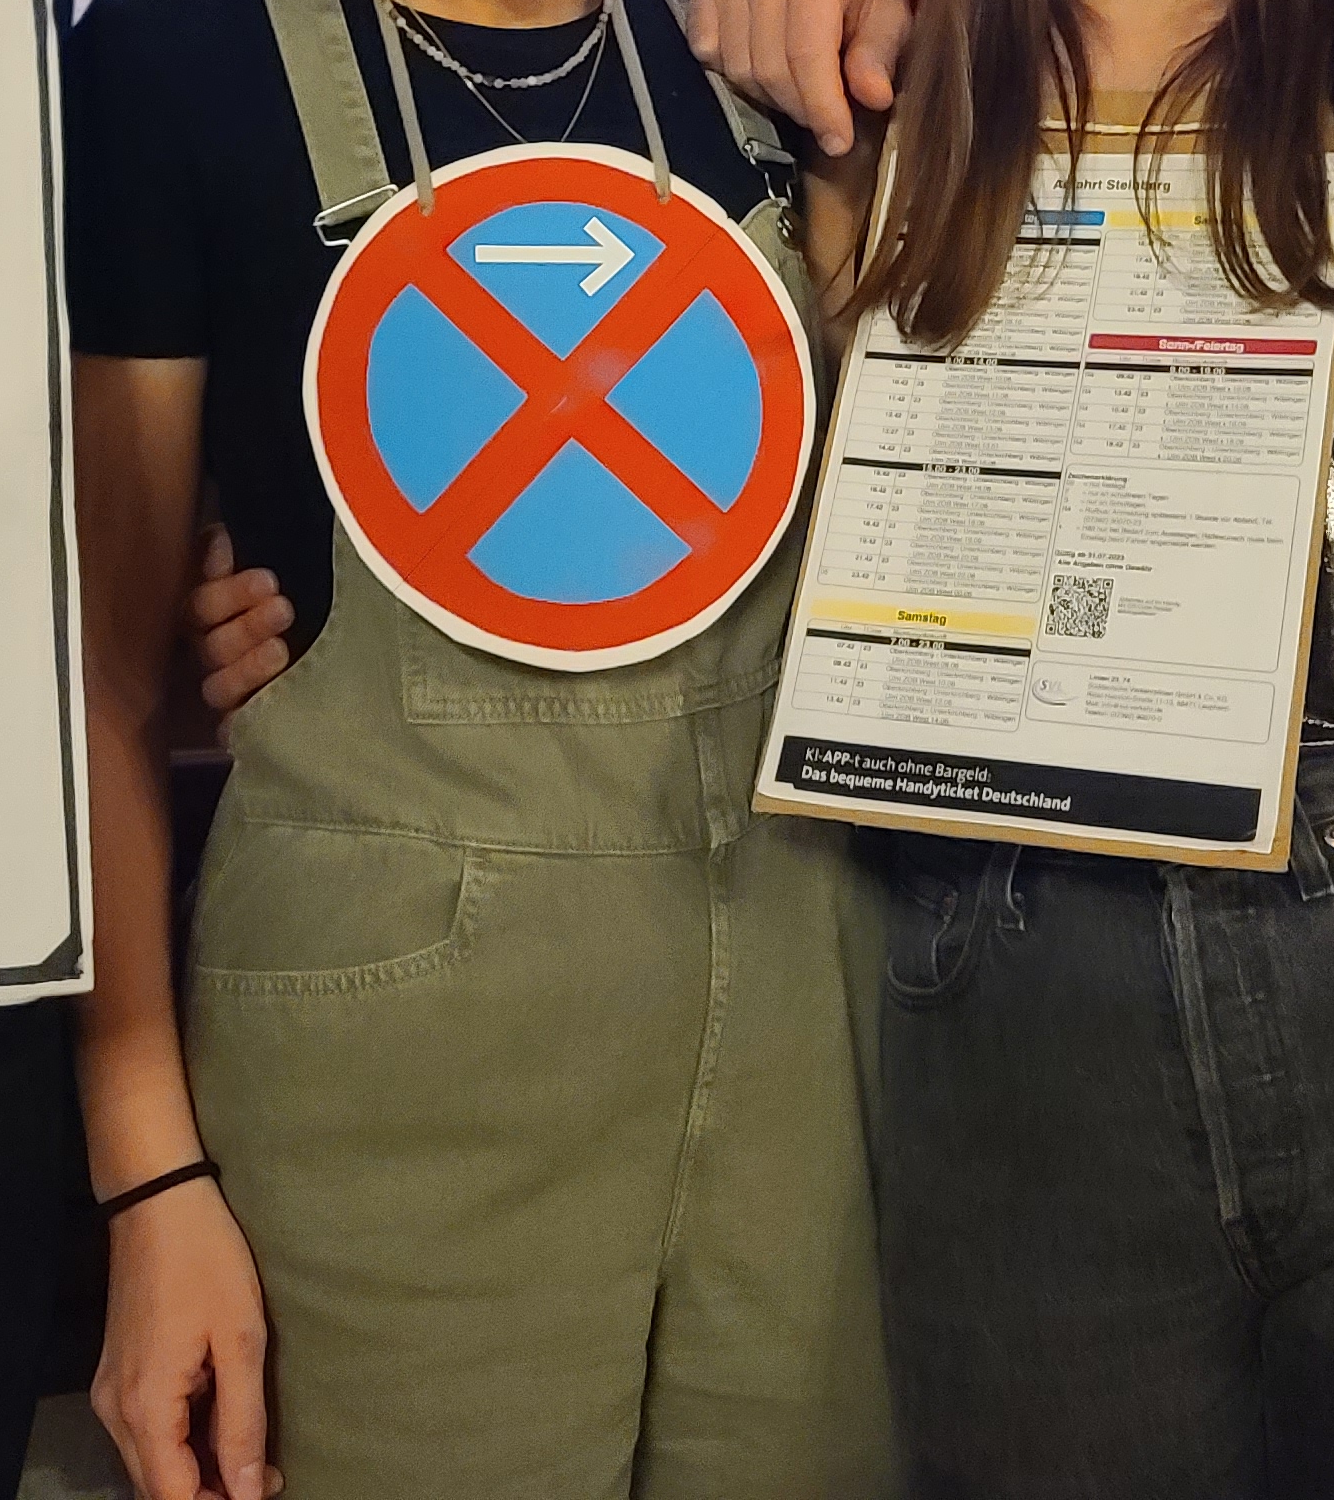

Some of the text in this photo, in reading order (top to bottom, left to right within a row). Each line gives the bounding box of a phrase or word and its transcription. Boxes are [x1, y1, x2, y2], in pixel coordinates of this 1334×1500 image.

[896, 610, 947, 626] Samstag
[888, 637, 911, 646] 7.00
[917, 639, 945, 650] 23.00
[863, 756, 895, 772] auch
[898, 759, 933, 776] ohne
[801, 765, 1072, 811] Das bequeme Handyticket Deutschland
